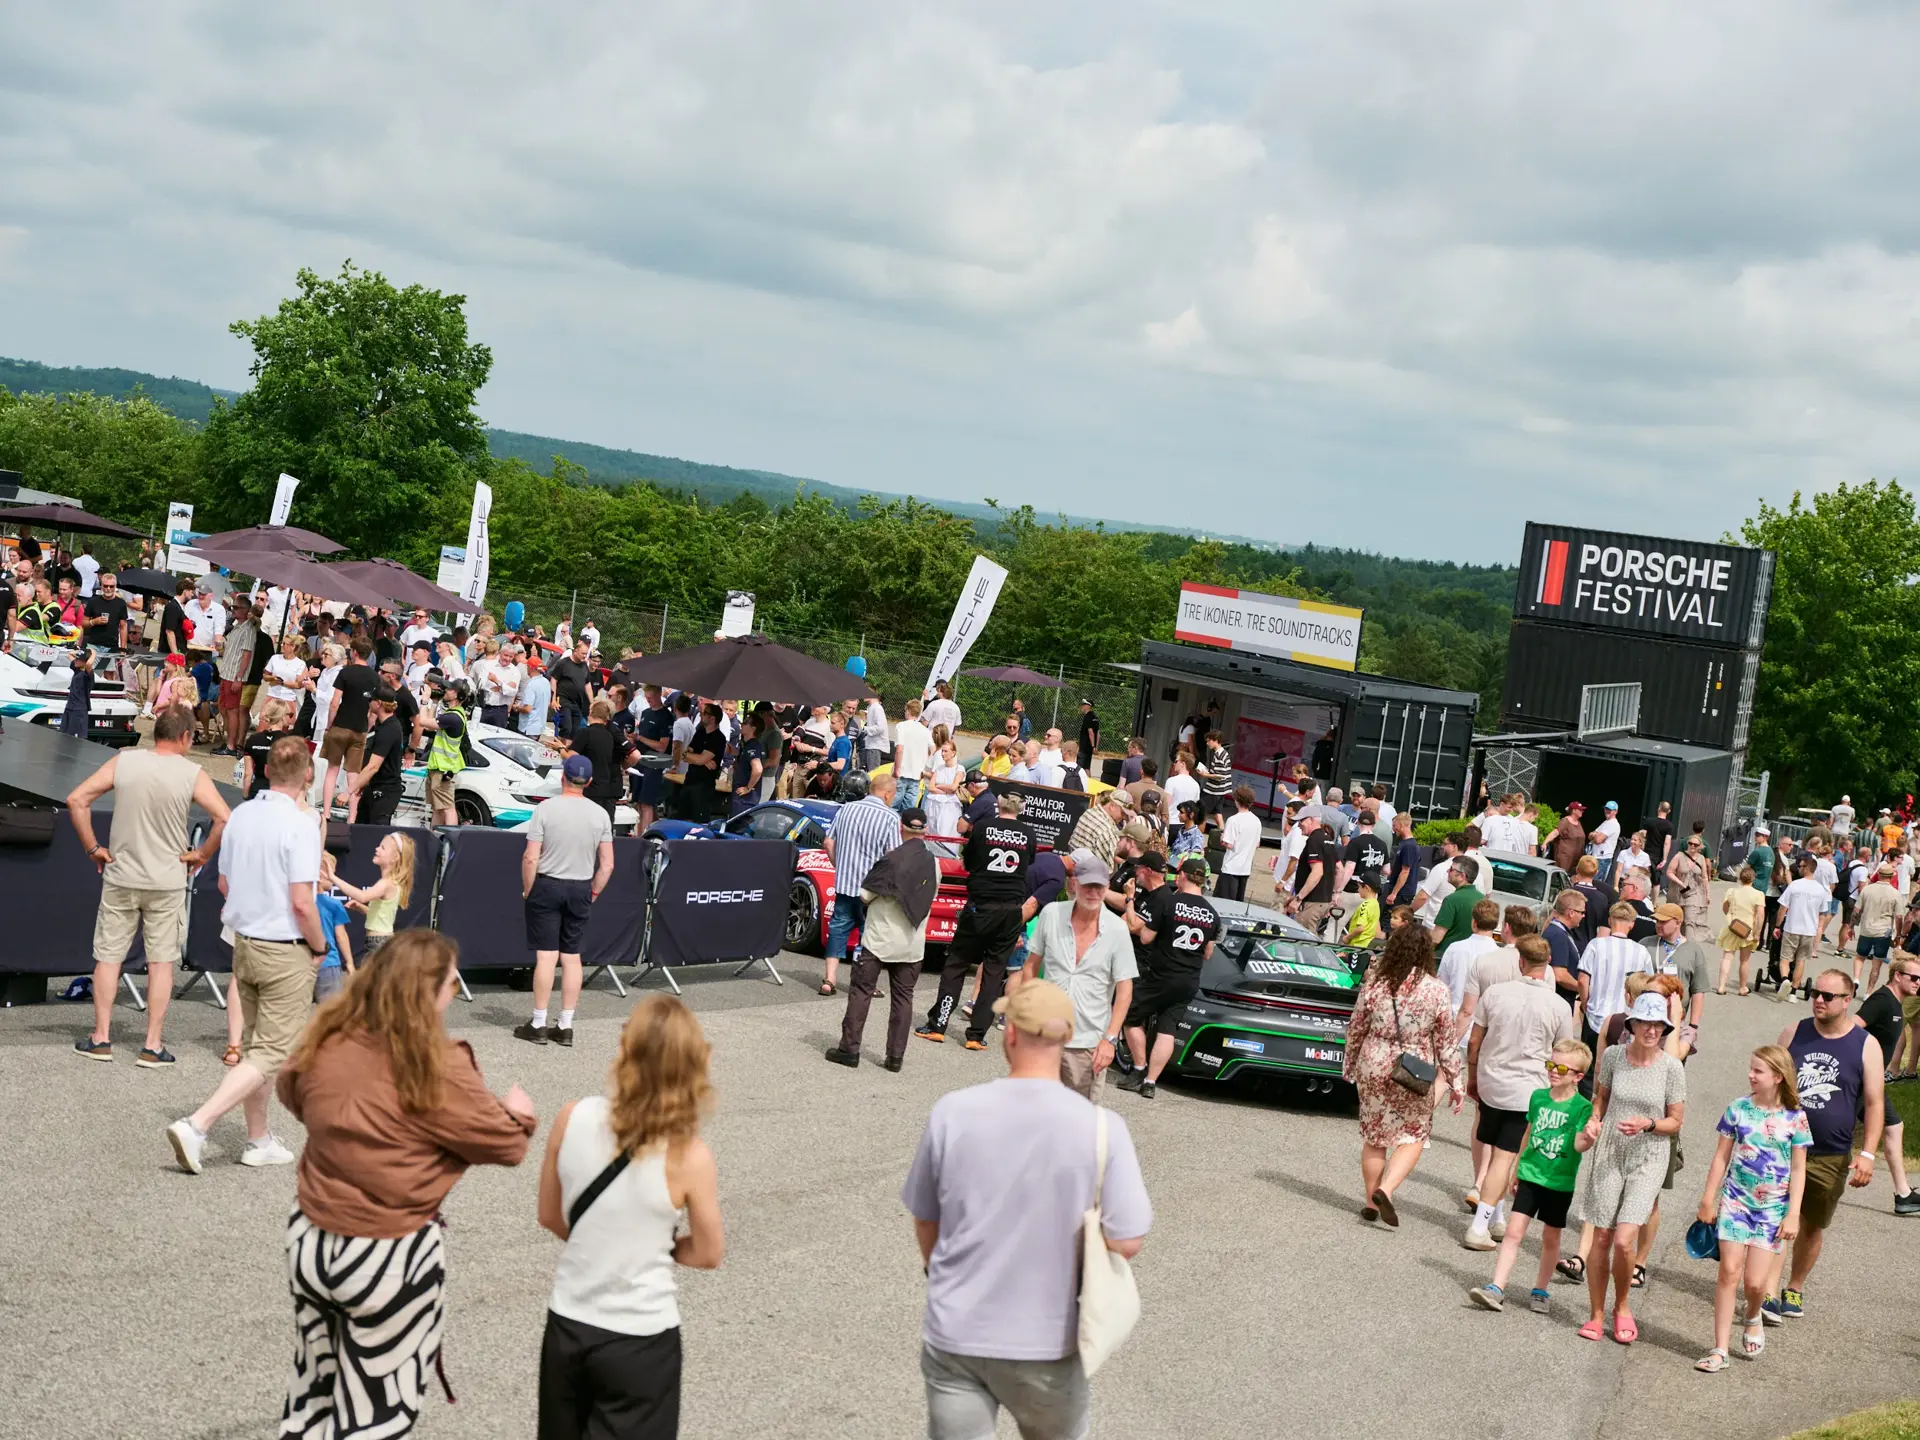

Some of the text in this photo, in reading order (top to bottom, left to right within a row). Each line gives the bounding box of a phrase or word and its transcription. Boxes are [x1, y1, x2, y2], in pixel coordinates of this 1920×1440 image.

[1579, 544, 1732, 592] PORSCHE
[1574, 579, 1723, 627] FESTIVAL
[1183, 602, 1354, 647] TRE IKONER. TRE SOUNDTRACKS.
[1047, 799, 1065, 811] FOR
[1035, 808, 1072, 823] RAMPEN
[987, 848, 1020, 873] 20
[686, 889, 764, 904] PORSCHE
[1172, 925, 1205, 951] 20
[1297, 964, 1339, 980] GROUP
[1290, 1013, 1350, 1025] PORSCH
[1305, 1047, 1334, 1062] Mobil
[1804, 1052, 1833, 1063] WELCOME
[1536, 1106, 1570, 1127] SKATE
